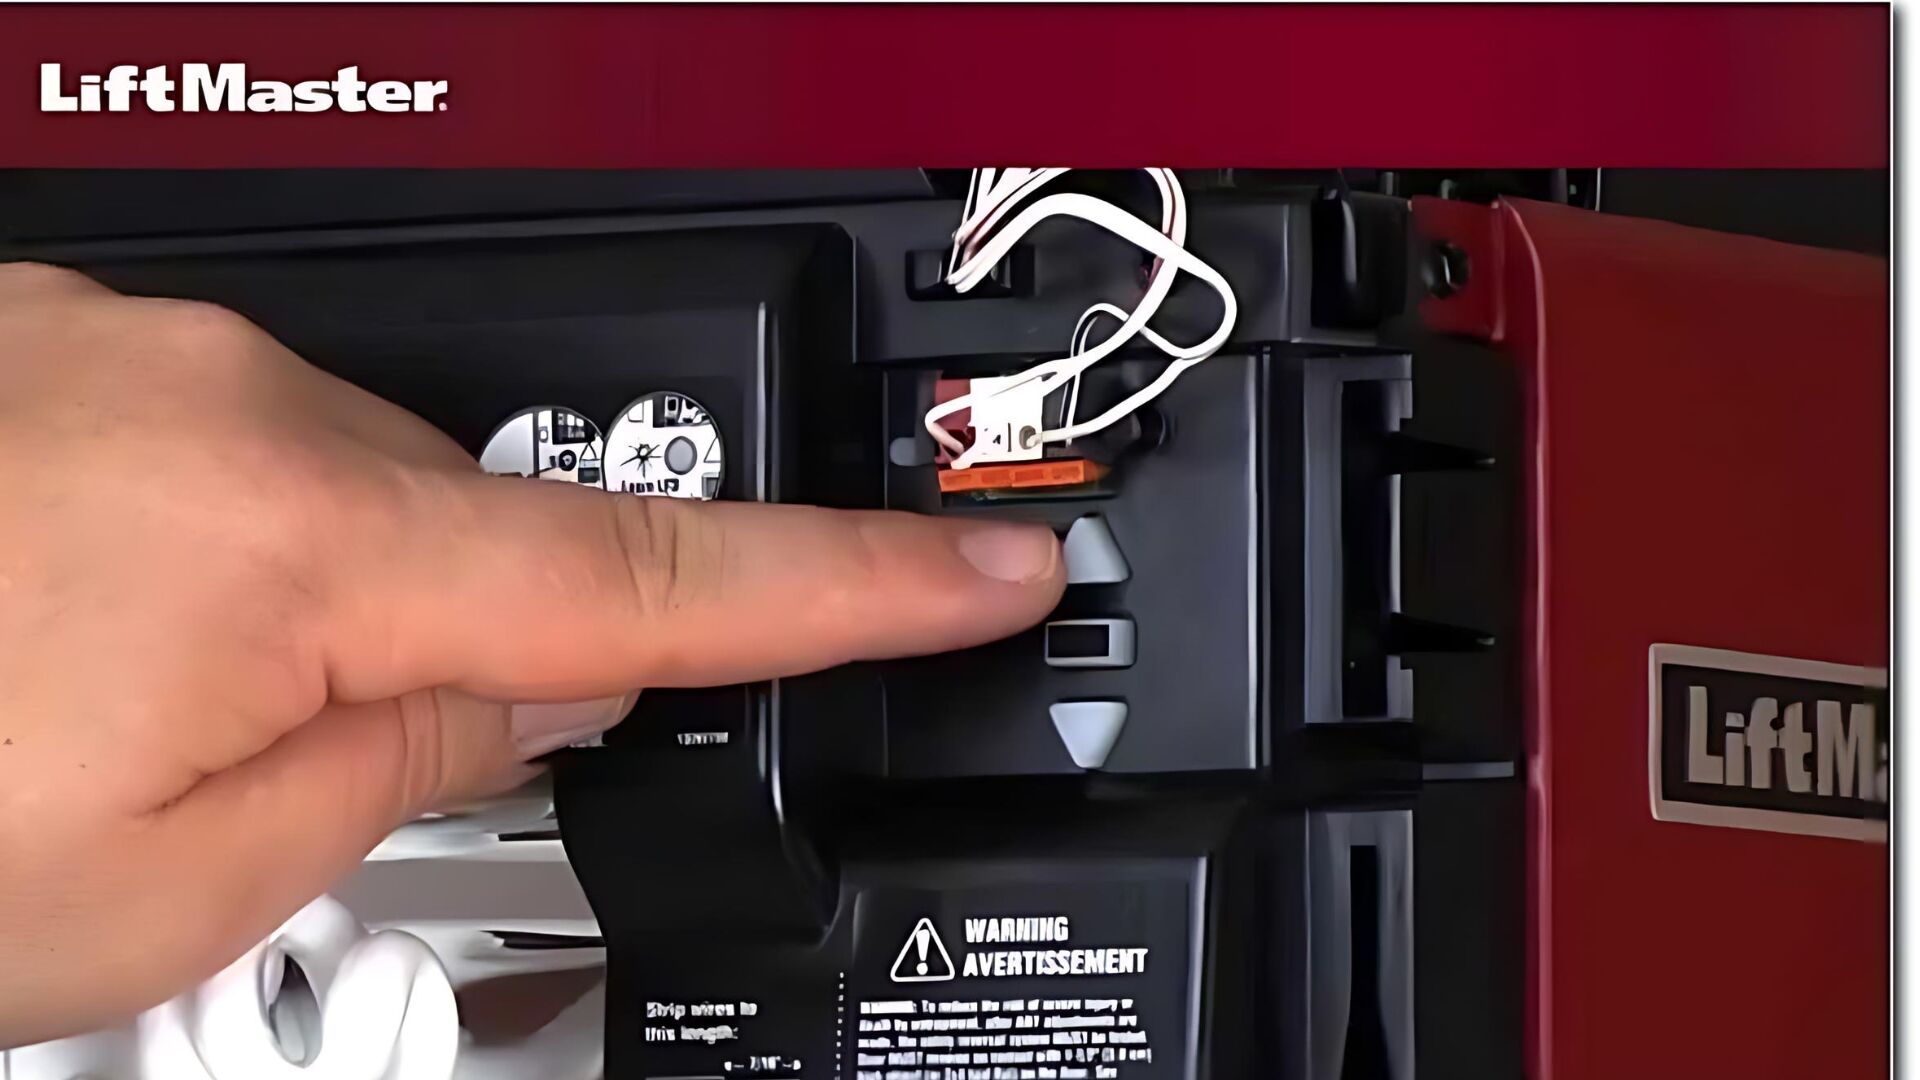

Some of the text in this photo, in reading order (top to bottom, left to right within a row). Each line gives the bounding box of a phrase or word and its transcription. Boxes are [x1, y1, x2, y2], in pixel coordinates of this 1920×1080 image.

[1686, 685, 1887, 801] LiftM
[965, 917, 1069, 943] WARNING
[963, 948, 1148, 977] AVERTISSEMENT
